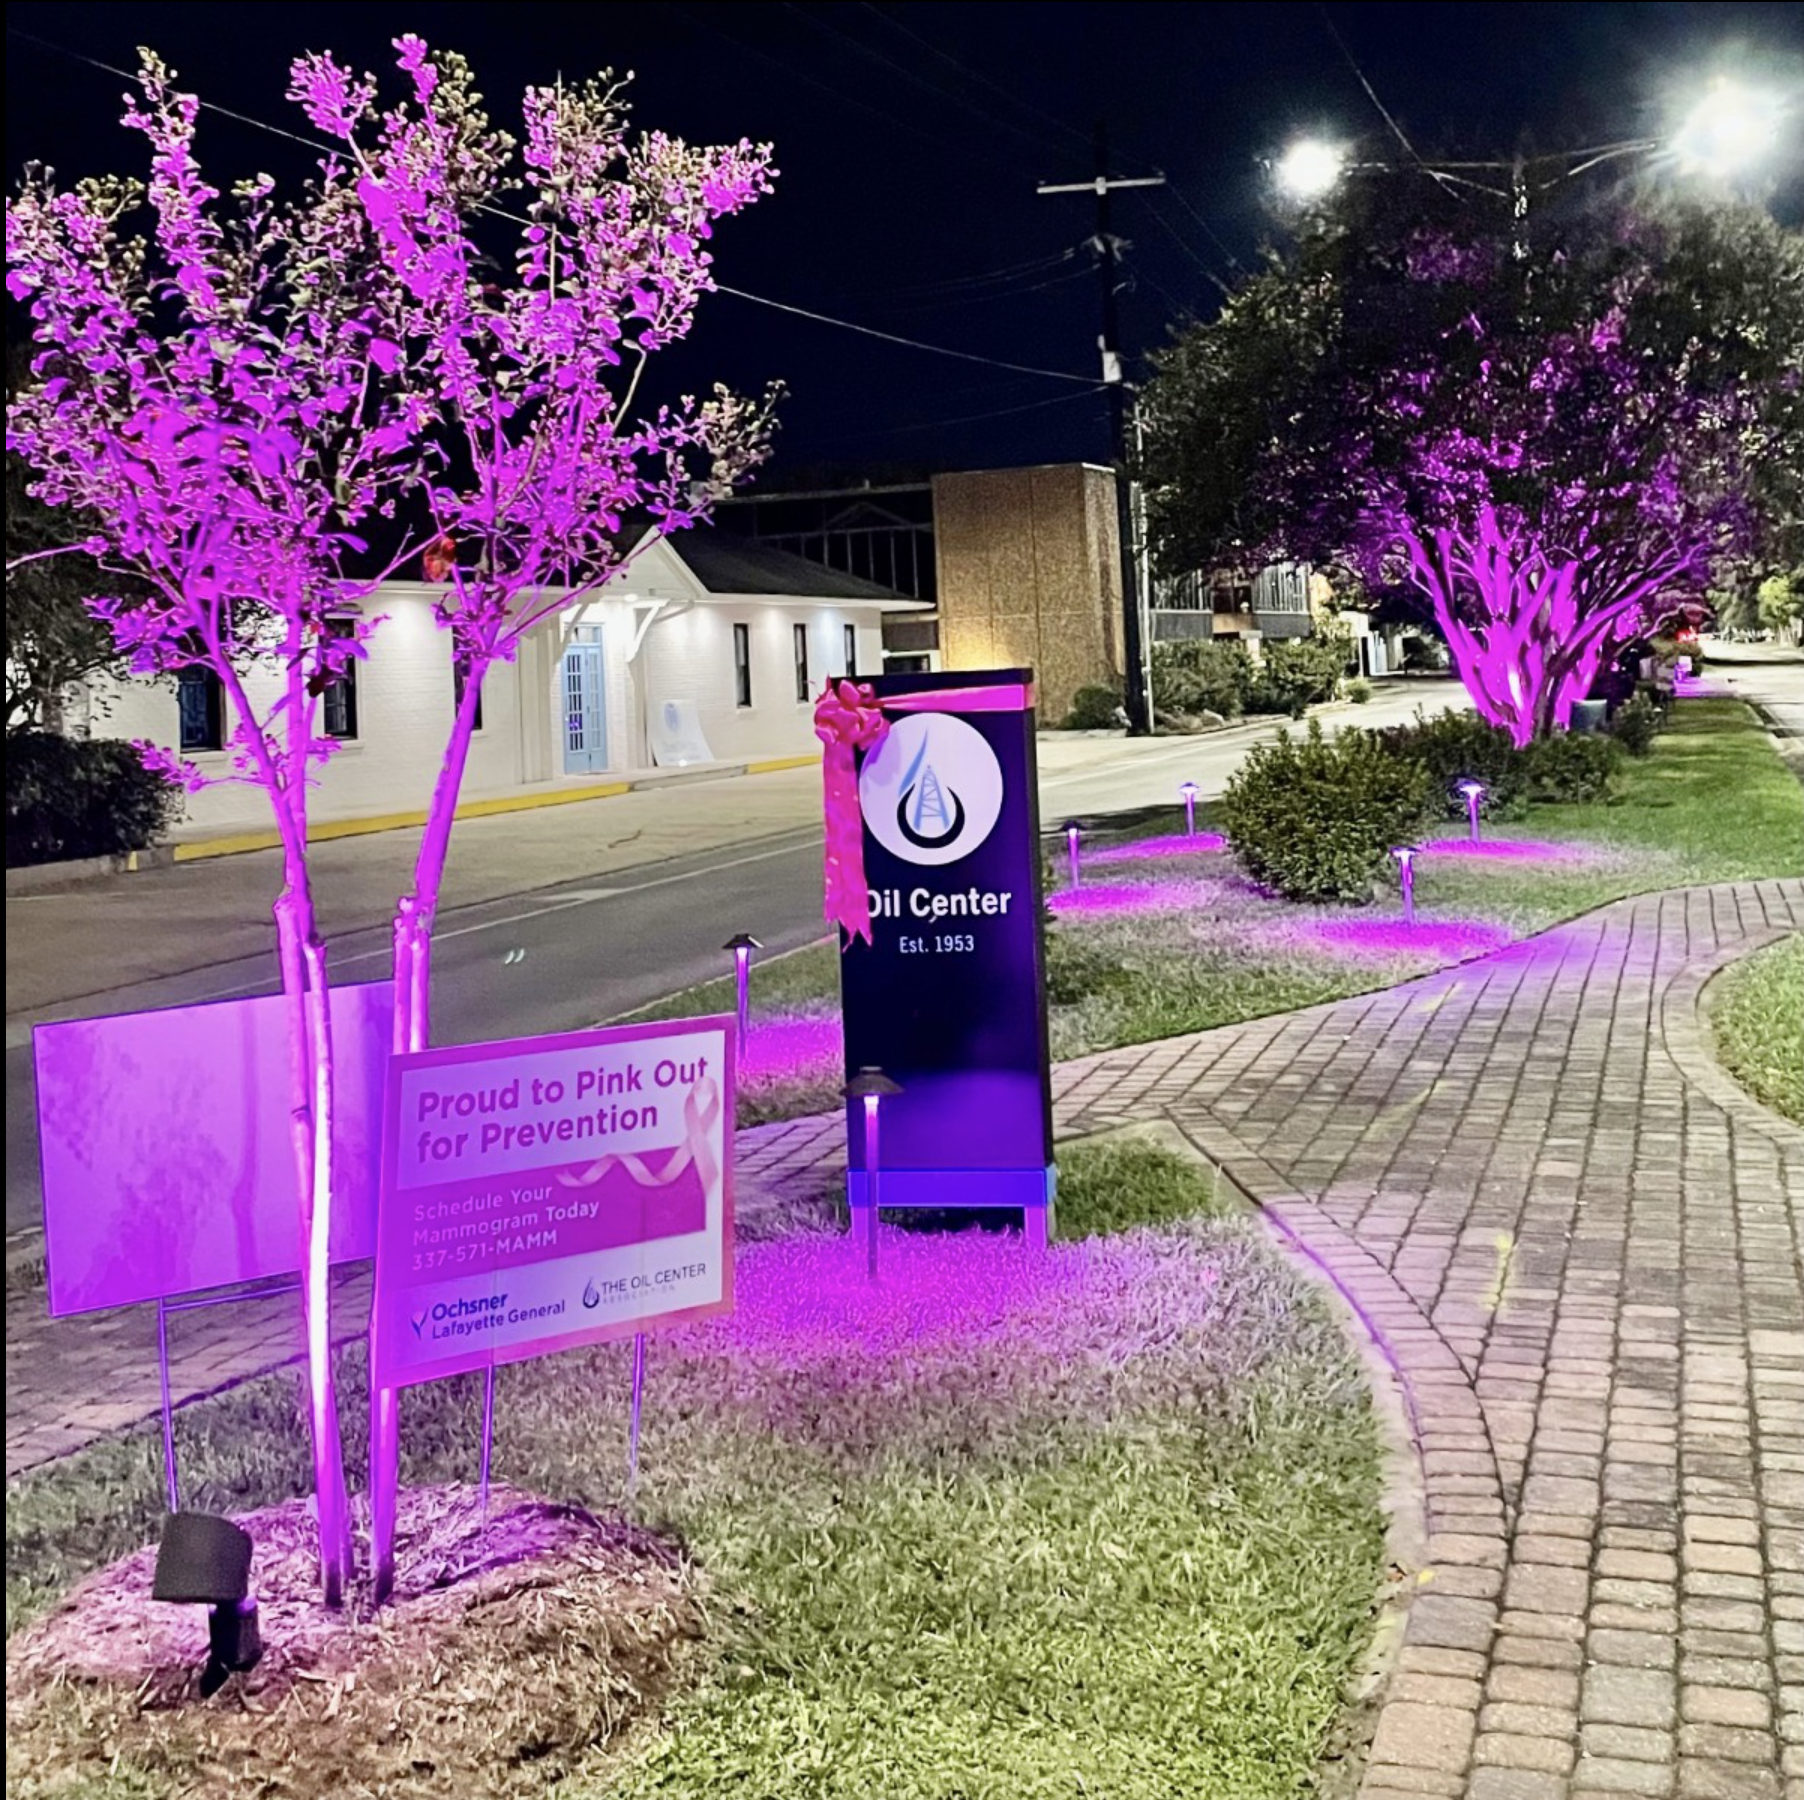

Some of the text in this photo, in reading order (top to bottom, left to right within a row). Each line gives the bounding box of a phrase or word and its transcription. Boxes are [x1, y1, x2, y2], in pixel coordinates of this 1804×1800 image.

[867, 887, 1012, 917] Oil Center
[899, 935, 974, 953] Est. 1953
[418, 1057, 708, 1122] Proud to Pink Out
[418, 1104, 658, 1163] for Prevention
[414, 1187, 552, 1221] Schedule Your
[413, 1201, 599, 1246] Mammogram Today
[412, 1229, 557, 1271] 337-571-MAMM
[602, 1278, 627, 1294] THE
[631, 1275, 651, 1289] OIL
[654, 1263, 706, 1284] CENTER
[432, 1293, 508, 1321] Ochsner
[432, 1299, 565, 1339] Lafayette General
